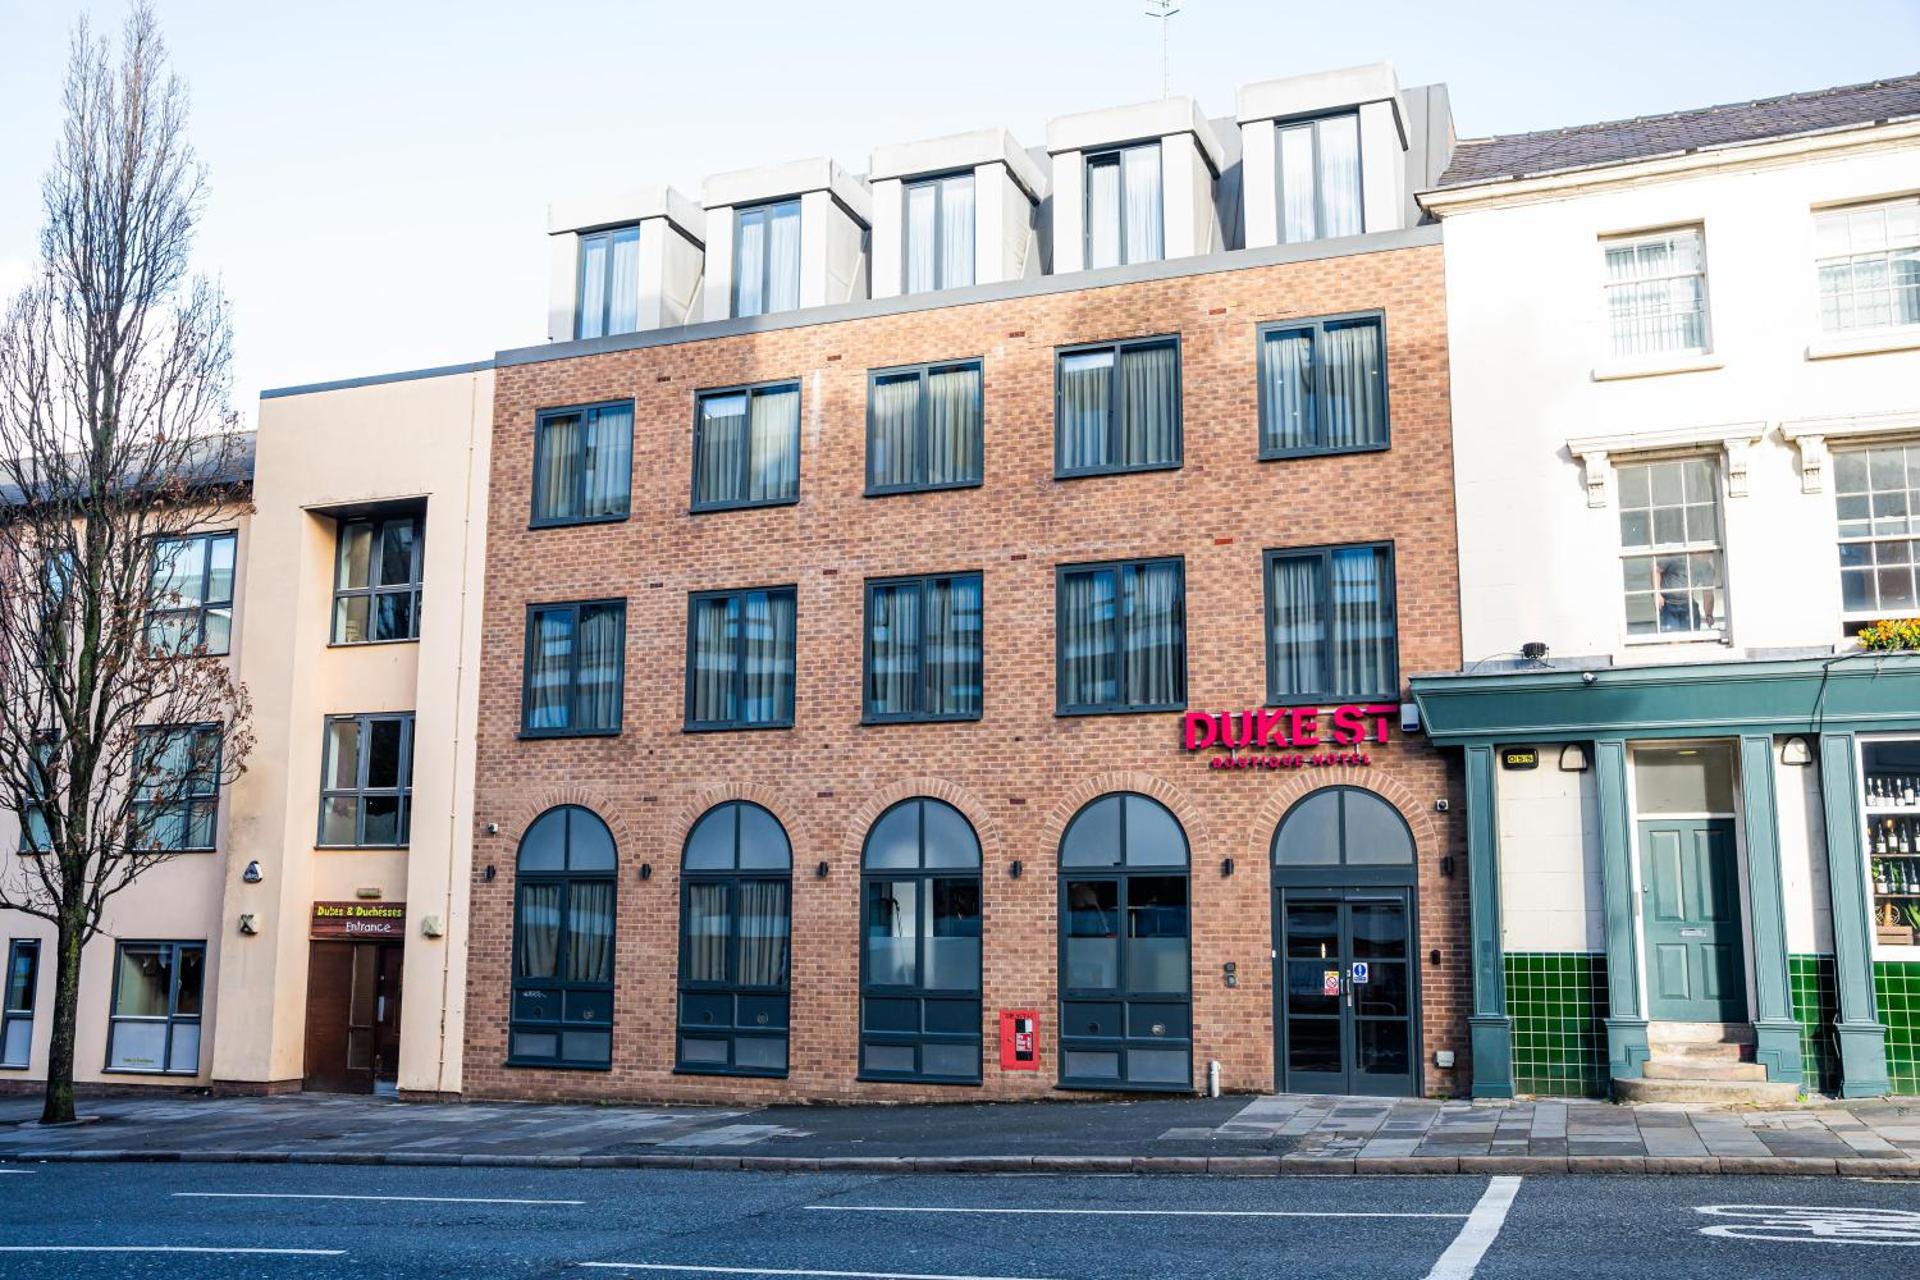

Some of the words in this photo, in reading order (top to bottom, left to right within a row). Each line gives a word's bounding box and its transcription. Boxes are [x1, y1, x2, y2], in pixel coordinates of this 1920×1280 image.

[1184, 706, 1320, 750] DUKE
[1333, 704, 1397, 745] ST
[1211, 753, 1304, 769] BOUTIQUE
[1312, 752, 1372, 767] HOTEL
[346, 906, 353, 916] &
[346, 921, 391, 932] Entrance
